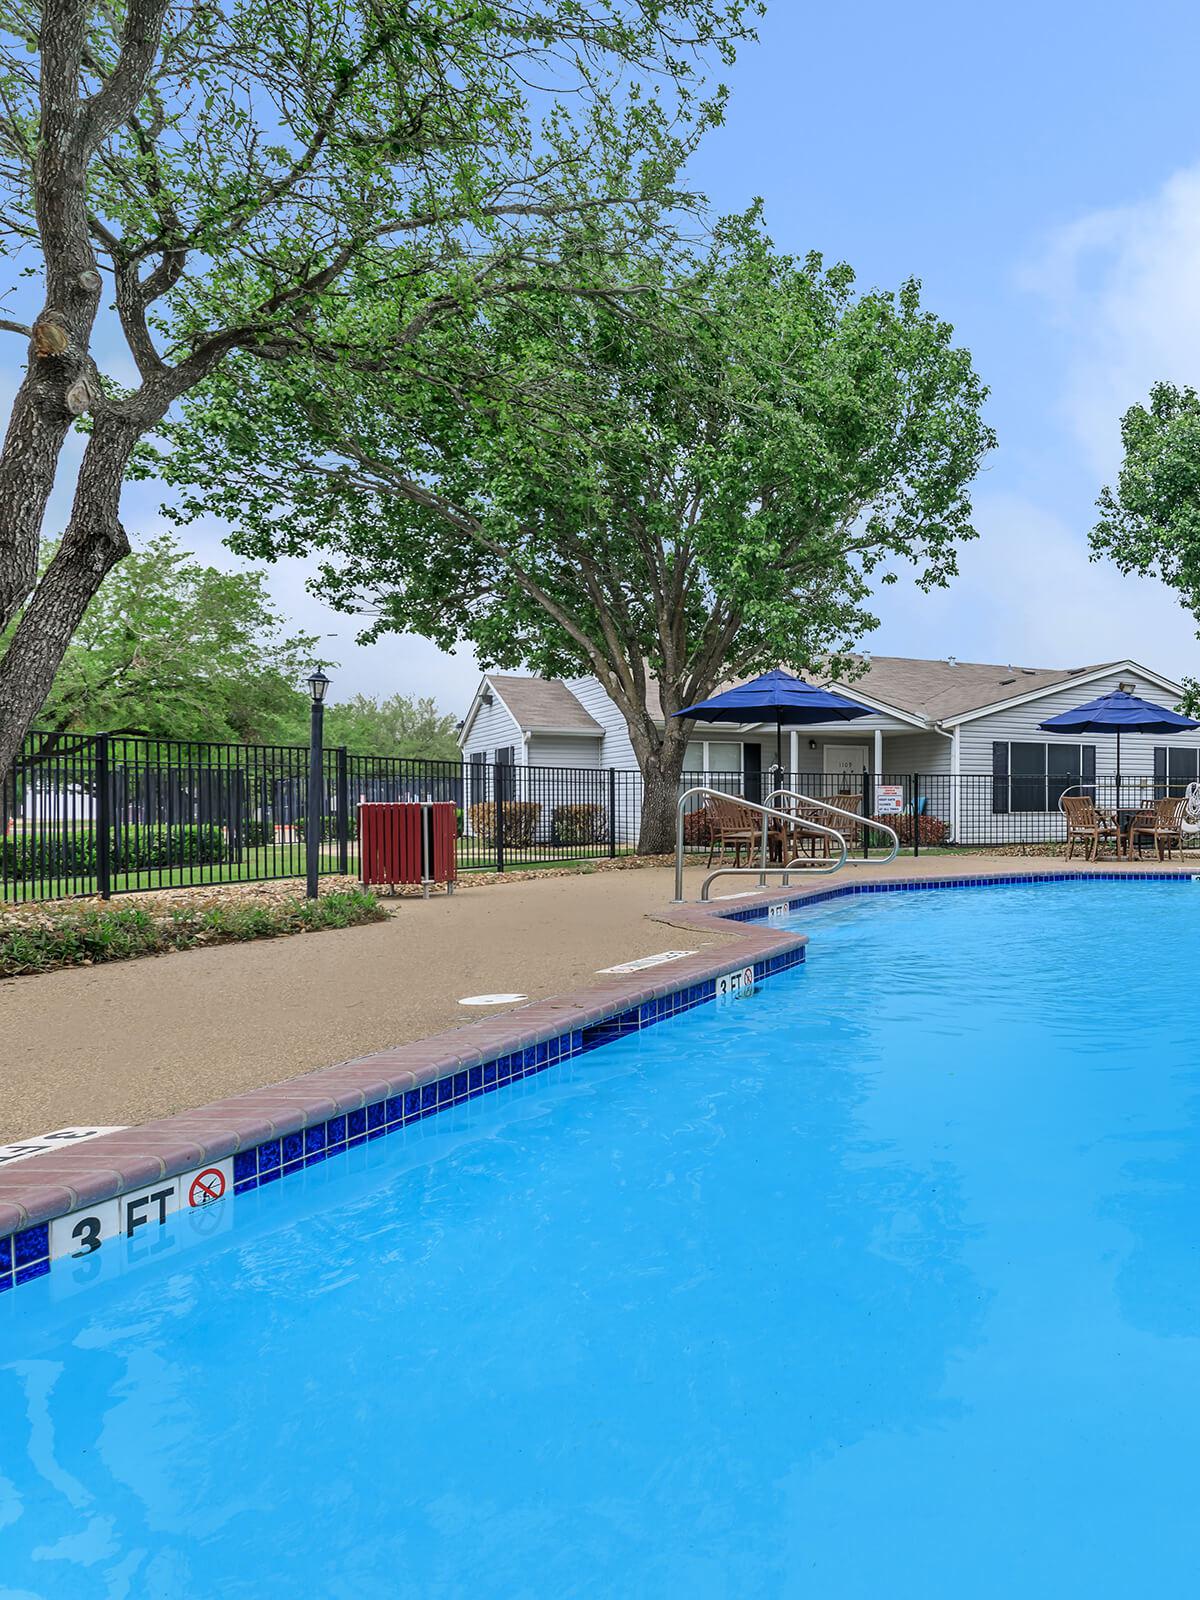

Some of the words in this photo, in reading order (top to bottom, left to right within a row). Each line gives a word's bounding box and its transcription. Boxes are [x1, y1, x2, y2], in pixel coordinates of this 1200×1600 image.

[730, 974, 742, 992] FT
[71, 1216, 102, 1259] 3
[127, 1186, 175, 1239] FT
